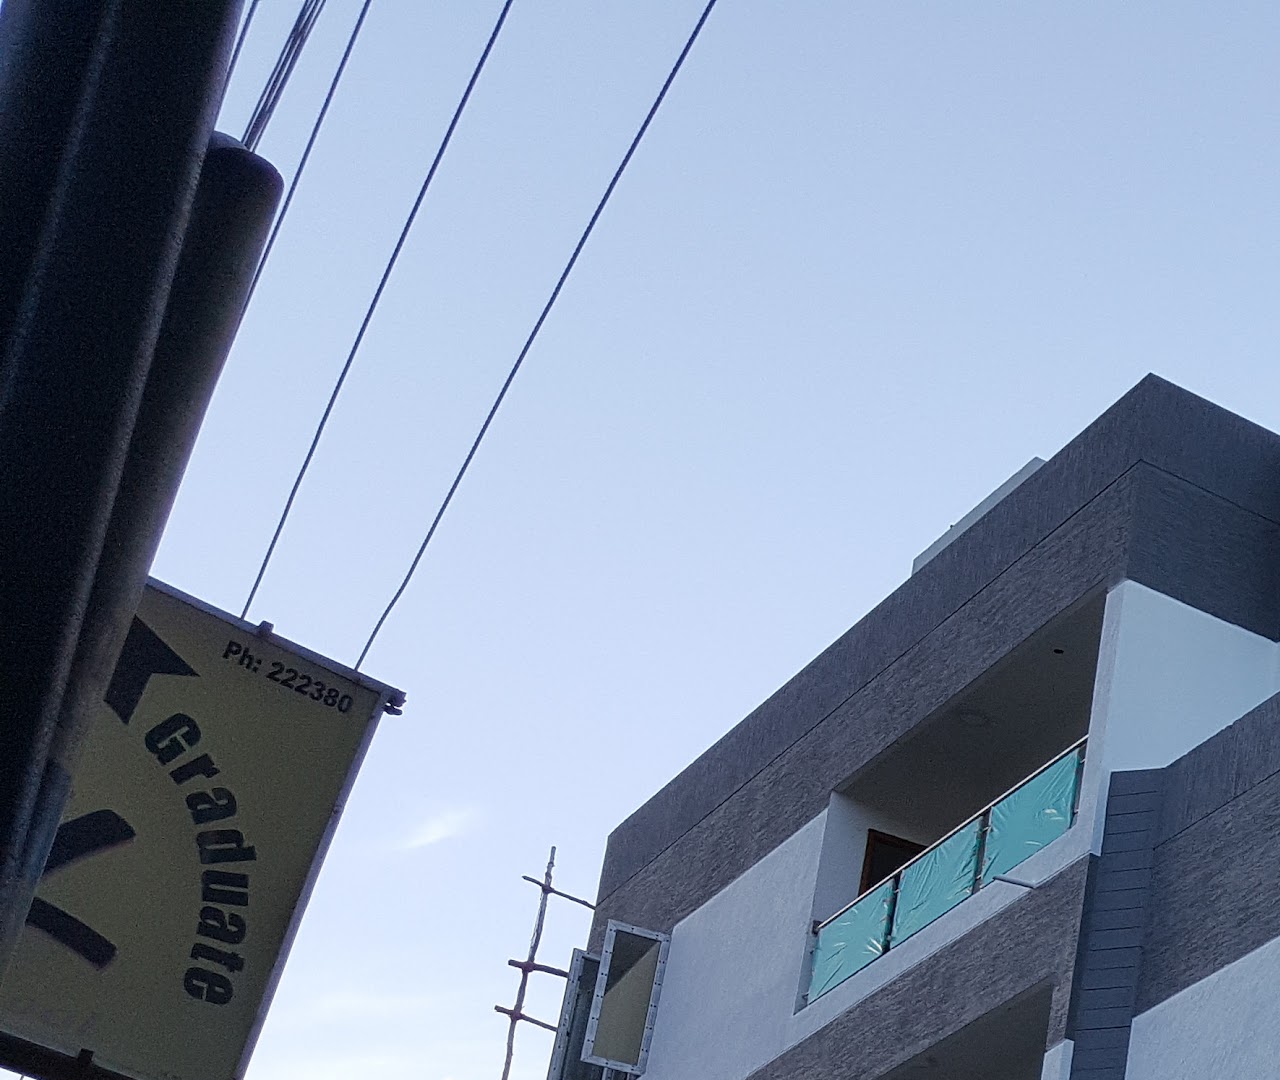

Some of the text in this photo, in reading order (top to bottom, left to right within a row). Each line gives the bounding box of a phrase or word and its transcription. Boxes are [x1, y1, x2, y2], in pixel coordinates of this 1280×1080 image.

[222, 640, 352, 714] Ph: 222380
[145, 713, 256, 1004] Graduate
